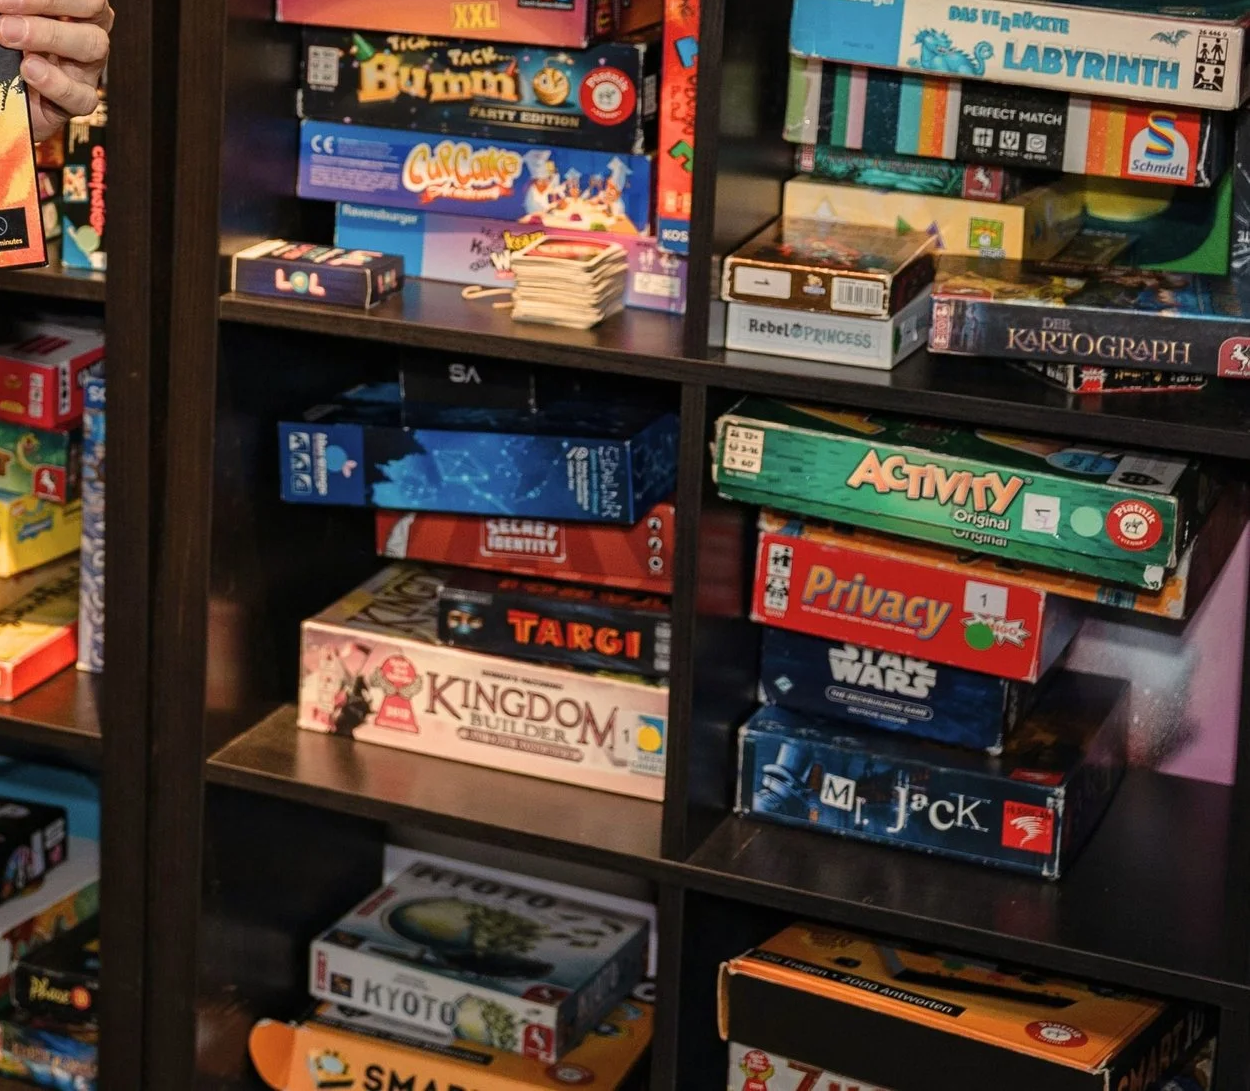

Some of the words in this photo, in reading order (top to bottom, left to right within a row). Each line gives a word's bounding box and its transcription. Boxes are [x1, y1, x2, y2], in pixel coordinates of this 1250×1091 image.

[453, 2, 500, 29] XXL
[949, 5, 979, 23] DAS
[357, 51, 520, 104] Bumm
[1003, 41, 1181, 91] LABYRINTH
[468, 106, 517, 122] PARTY
[521, 110, 580, 129] EDITION
[963, 104, 1017, 122] PERFECT
[1019, 110, 1063, 127] MATCH
[1131, 158, 1186, 177] Schmidt
[275, 268, 327, 297] LOL
[749, 318, 790, 337] Rebel
[802, 327, 872, 349] PRINCESS
[1042, 316, 1071, 330] DER
[1006, 327, 1193, 366] KARTOGRAPH
[953, 509, 1011, 532] Original
[1114, 502, 1157, 526] Piatnik
[487, 535, 559, 555] IDENTITY
[802, 564, 952, 640] Privacy
[507, 609, 642, 659] TARGI
[827, 656, 938, 700] WARS
[426, 671, 619, 750] KINGDOM
[470, 713, 571, 745] BUILDER
[824, 776, 870, 826] Mr.
[363, 978, 456, 1027] KYOTO
[882, 984, 954, 1015] Antworten
